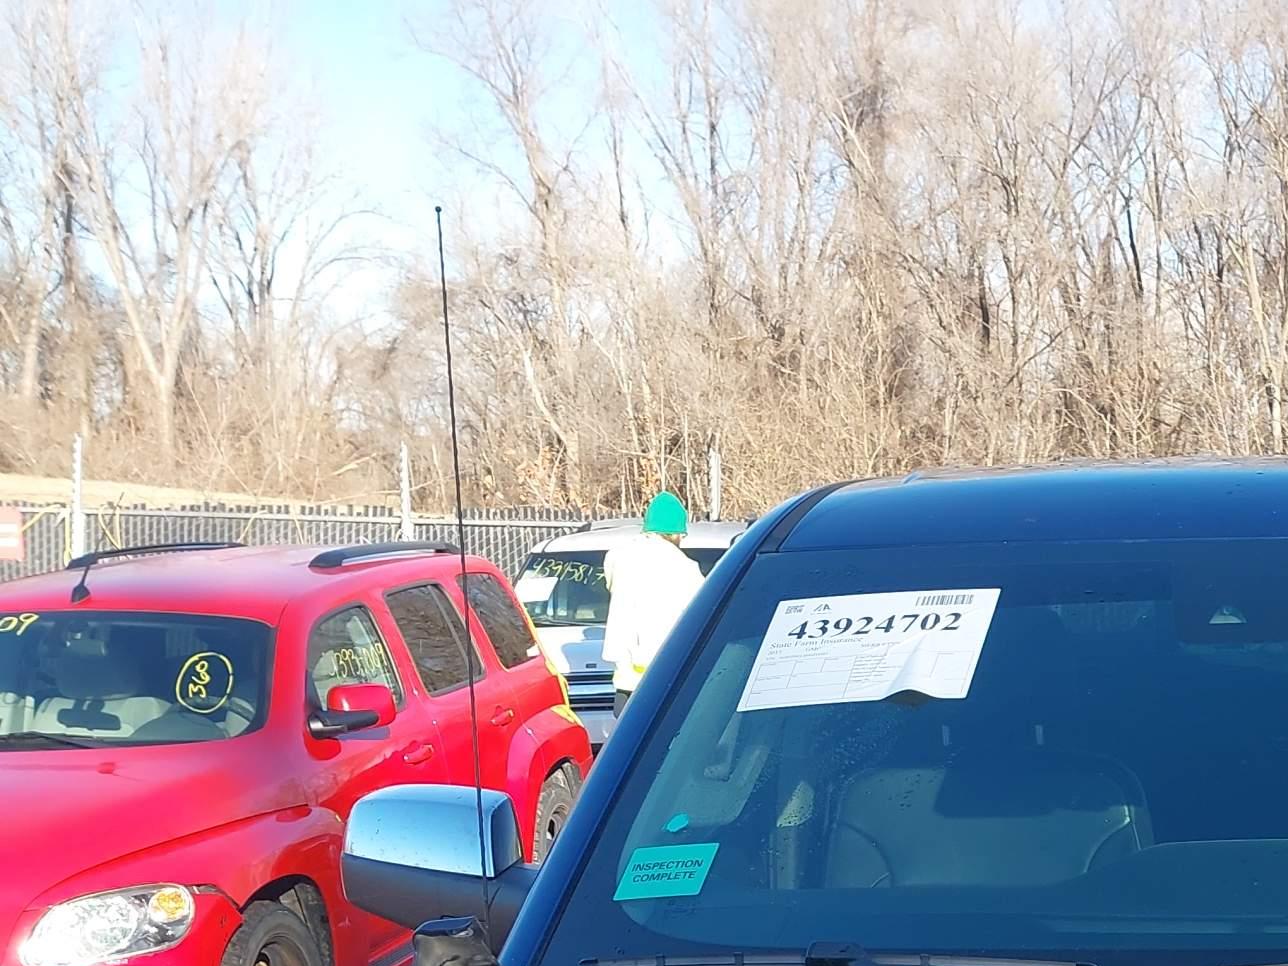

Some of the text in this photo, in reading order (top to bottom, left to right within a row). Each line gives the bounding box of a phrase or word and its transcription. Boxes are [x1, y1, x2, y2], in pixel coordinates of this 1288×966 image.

[788, 612, 962, 639] 43924702
[632, 859, 704, 872] INSPECTION
[632, 871, 697, 883] COMPLETE
